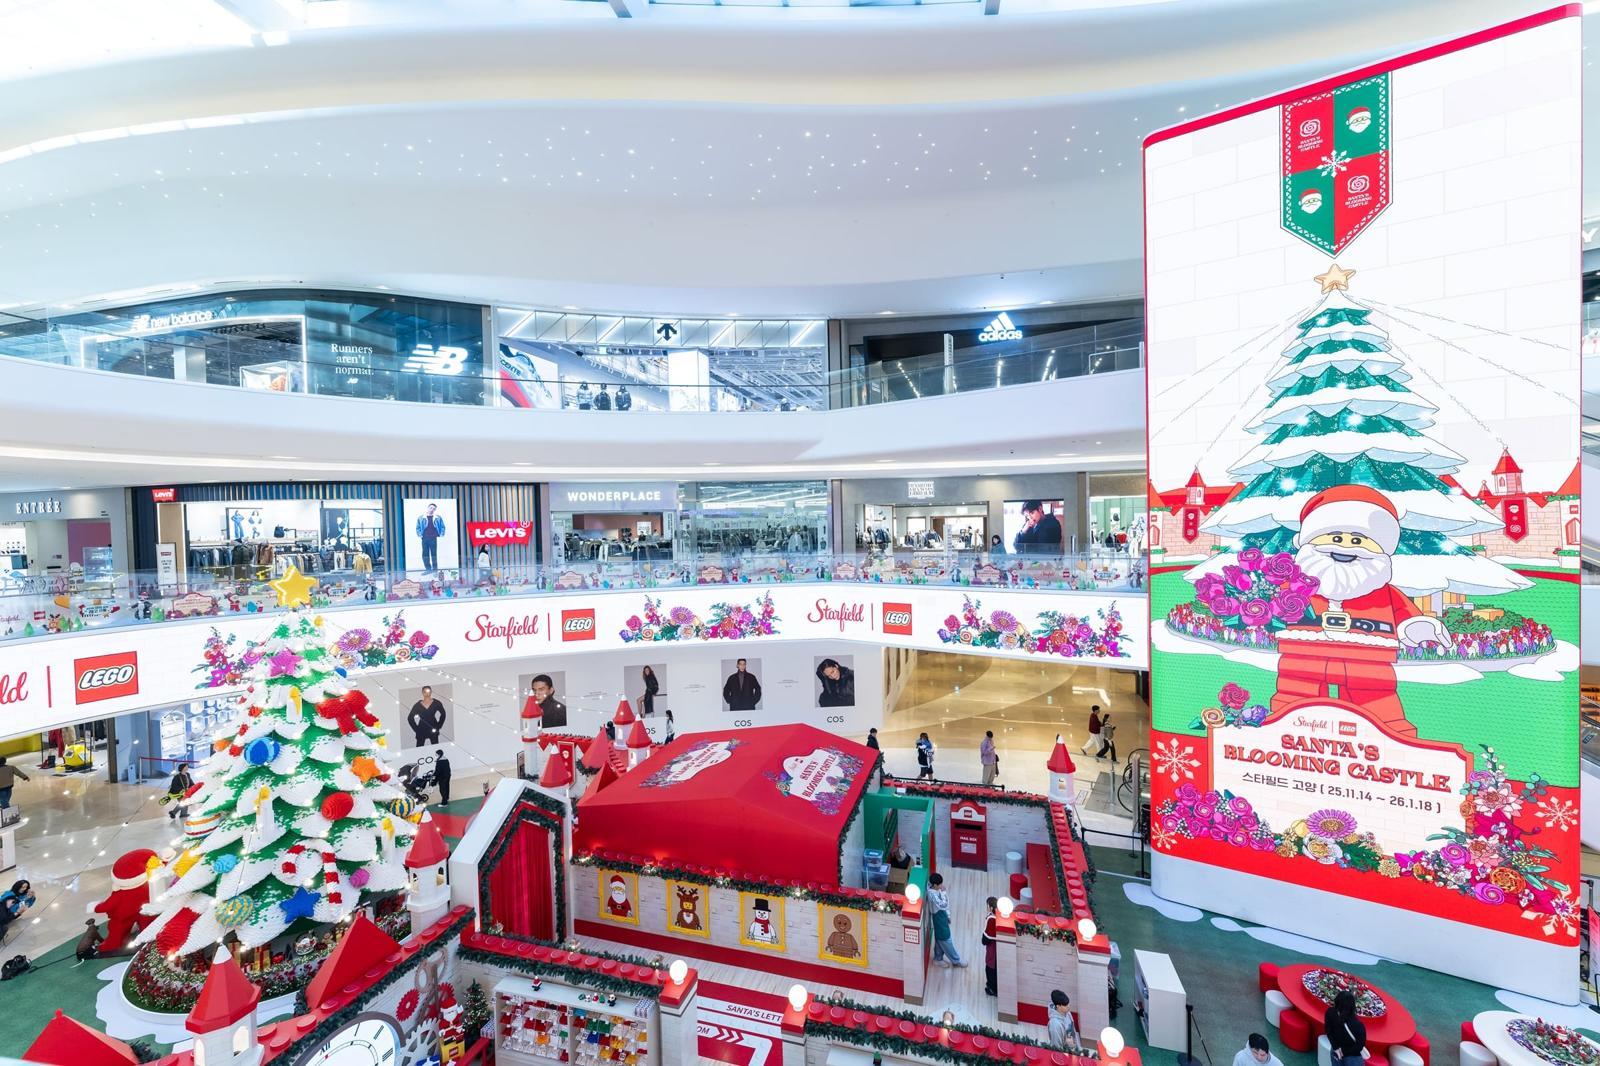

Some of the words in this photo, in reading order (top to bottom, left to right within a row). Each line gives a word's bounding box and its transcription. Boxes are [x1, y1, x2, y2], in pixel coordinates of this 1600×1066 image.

[978, 329, 1023, 342] adidas
[331, 343, 373, 354] Runners
[336, 354, 366, 364] aren't
[567, 491, 661, 501] WONDERPLACE
[16, 497, 62, 514] ENTRÉE
[807, 598, 864, 632] Starfield
[884, 610, 910, 627] LEGO
[464, 614, 539, 649] Starfield
[564, 617, 594, 632] LEGO
[78, 664, 136, 690] LEGO
[734, 719, 752, 727] COS
[1293, 715, 1327, 732] Starfield
[1281, 734, 1380, 761] SANTA'S
[417, 756, 434, 765] CO
[1224, 745, 1340, 776] BLOOMING
[1347, 763, 1452, 793] CASTLE
[1242, 772, 1289, 788] 스타필드
[1292, 780, 1317, 793] 고양
[1328, 786, 1373, 802] 25.11.14
[1389, 796, 1433, 812] 26.1.18
[726, 1004, 761, 1018] SANTA'S
[761, 1010, 782, 1022] LETT
[697, 1026, 710, 1035] OM
